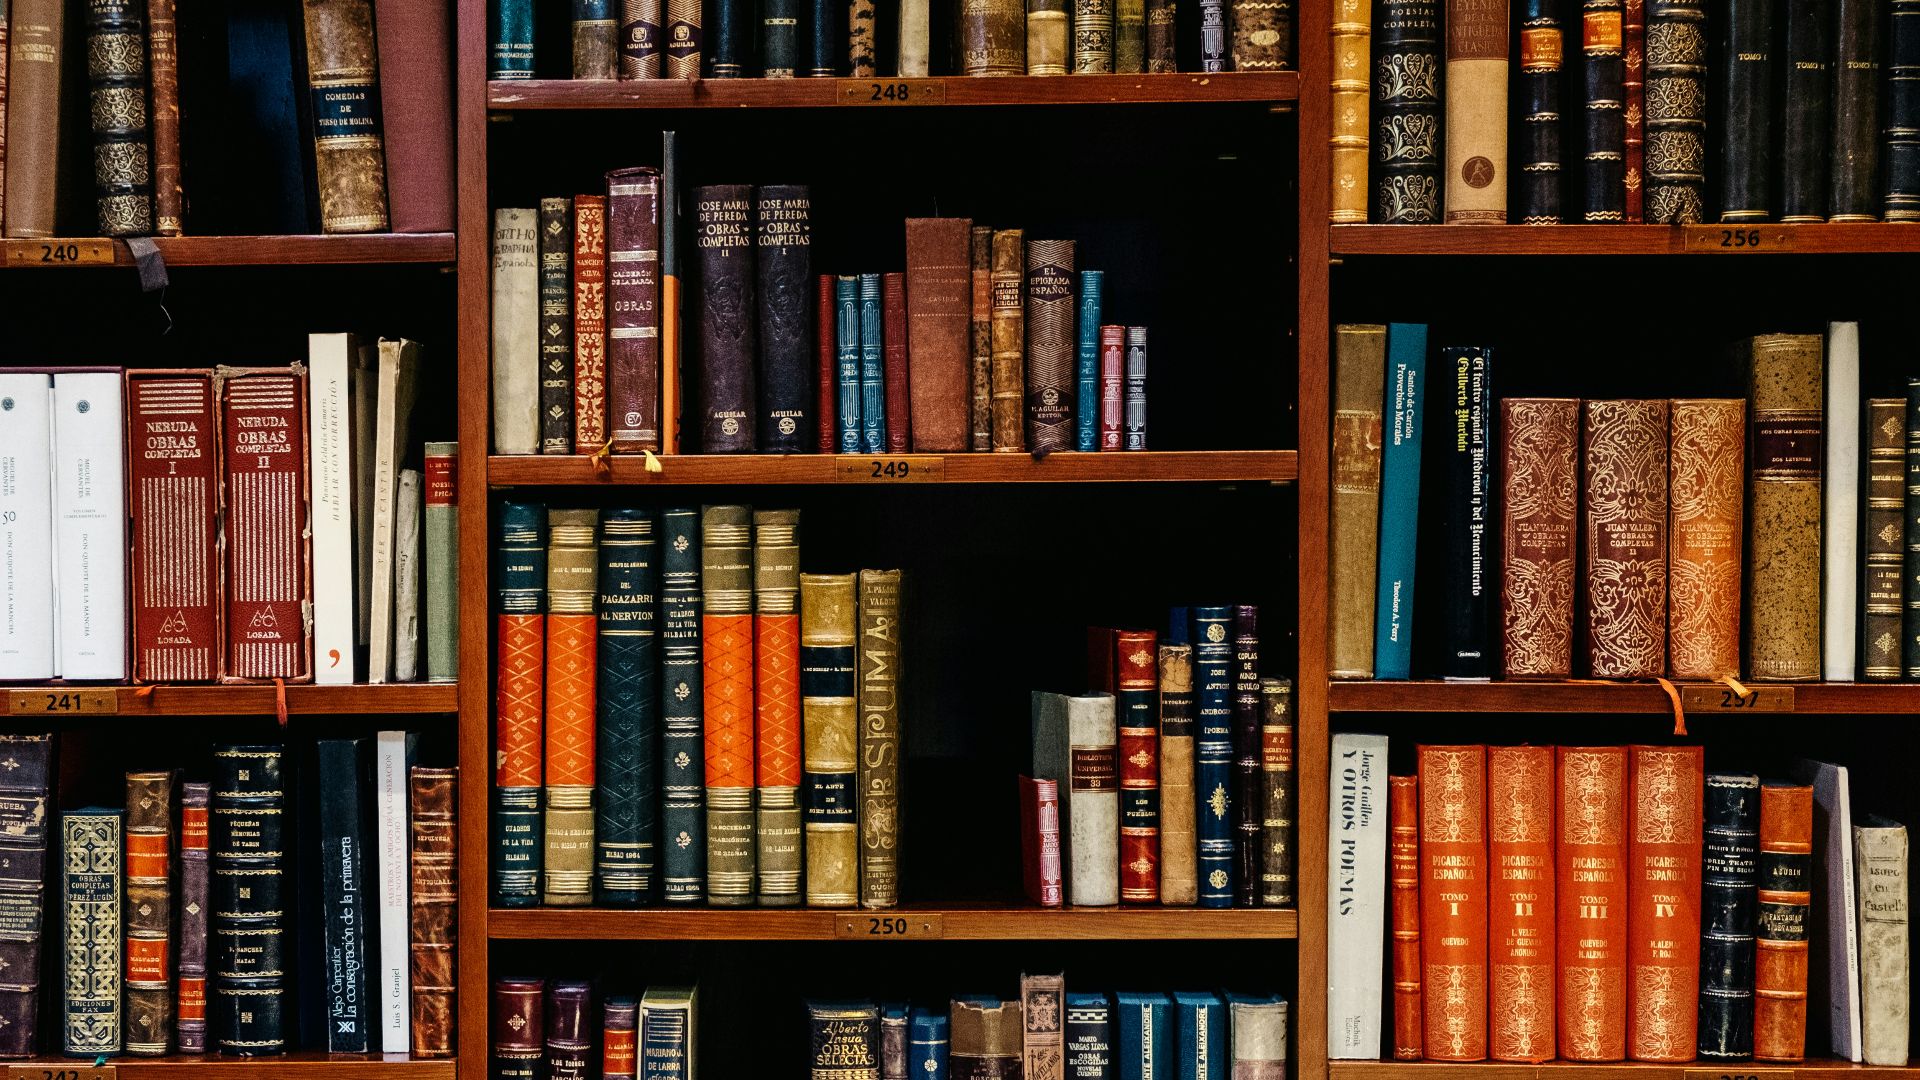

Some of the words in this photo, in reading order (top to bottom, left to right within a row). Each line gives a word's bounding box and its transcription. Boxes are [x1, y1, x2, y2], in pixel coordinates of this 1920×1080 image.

[1738, 53, 1762, 61] TOMO
[325, 92, 365, 101] COMEDIAS
[871, 83, 909, 101] 248
[340, 105, 352, 113] DE
[722, 200, 750, 210] MARIA
[758, 199, 781, 210] JOSE
[783, 199, 810, 209] MARIA
[699, 212, 710, 222] DE
[713, 211, 748, 222] PEREDA
[760, 210, 771, 220] DE
[774, 210, 809, 220] PEREDA
[706, 223, 740, 235] OBRAS
[766, 222, 801, 234] OBRAS
[697, 235, 750, 248] COMPLETAS
[758, 234, 810, 246] COMPLETAS
[1720, 230, 1760, 248] 256
[41, 245, 79, 261] 240
[721, 249, 729, 257] II
[782, 247, 787, 256] I
[1044, 267, 1057, 276] EL
[1030, 277, 1071, 286] EPIGRAMA
[1030, 284, 1070, 295] ESPAÑOL
[614, 301, 653, 312] OBRAS
[1394, 363, 1407, 410] Proverbios
[1406, 370, 1416, 398] Santob
[713, 410, 747, 418] AGUILAR
[770, 410, 803, 418] AGUILAR
[145, 421, 198, 433] NERUDA
[236, 416, 288, 428] NERUDA
[1405, 409, 1414, 439] Carrión
[1393, 410, 1405, 446] Morales
[146, 435, 197, 449] OBRAS
[237, 430, 287, 444] OBRAS
[144, 448, 201, 459] COMPLETAS
[235, 443, 292, 454] COMPLETAS
[168, 461, 177, 475] I
[257, 456, 270, 469] II
[871, 461, 909, 478] 249
[1516, 523, 1540, 532] JUAN
[1541, 523, 1570, 532] VALERA
[1605, 523, 1628, 532] JUAN
[1629, 523, 1657, 532] VALERA
[1680, 523, 1704, 532] JUAN
[1532, 532, 1559, 540] OBRAS
[1621, 532, 1647, 540] OBRAS
[1696, 532, 1723, 540] OBRAS
[1521, 539, 1566, 548] COMPLETAS
[1609, 539, 1655, 547] COMPLETAS
[1685, 539, 1731, 548] COMPLETAS
[601, 594, 654, 604] PAGAZARRI
[601, 612, 611, 621] AL
[612, 611, 654, 621] NERVION
[157, 636, 192, 645] LOSADA
[246, 631, 281, 640] LOSADA
[1237, 652, 1258, 660] COPLAS
[1243, 662, 1252, 670] DE
[1239, 672, 1257, 680] MINGO
[46, 694, 83, 711] 241
[1720, 690, 1760, 708] 257
[1342, 750, 1357, 760] Y
[1089, 779, 1101, 788] 33
[1341, 768, 1357, 831] OTROS
[2, 859, 10, 868] 2
[338, 836, 357, 891] primavera
[1432, 855, 1476, 867] PICARESCA
[1502, 855, 1544, 867] PICARESCA
[1572, 857, 1616, 869] PICARESCA
[1645, 856, 1688, 868] PICARESCA
[1339, 840, 1356, 917] POEMAS
[1433, 868, 1475, 880] ESPAÑOLA
[1502, 868, 1543, 880] ESPAÑOLA
[1573, 870, 1615, 882] ESPAÑOLA
[1646, 869, 1687, 881] ESPAÑOLA
[71, 882, 110, 890] COMPLETAS
[339, 894, 353, 905] la
[1440, 893, 1469, 901] TOMO
[1509, 893, 1538, 901] TOMO
[1579, 895, 1609, 904] TOMO
[1652, 894, 1681, 903] TOMO
[1450, 902, 1459, 916] I
[1514, 902, 1534, 916] II
[1579, 905, 1609, 919] III
[1655, 903, 1679, 918] IV
[339, 907, 354, 926] de
[868, 918, 908, 934] 250
[1441, 937, 1469, 946] QUEVEDO
[1579, 939, 1608, 948] QUEVEDO
[343, 927, 361, 1003] consagración
[391, 967, 401, 998] Granjel
[343, 1004, 356, 1019] La
[392, 1012, 401, 1029] Luis
[822, 1021, 869, 1034] Alberto
[1143, 1007, 1151, 1061] ALEIXANDRE
[1197, 1007, 1206, 1061] ALEIXANDRE
[822, 1043, 868, 1055] OBRAS
[1068, 1042, 1090, 1050] VARGAS
[1090, 1042, 1109, 1050] LLOSA
[646, 1048, 676, 1057] MARIANO
[816, 1054, 875, 1066] SELECTAS
[647, 1062, 657, 1070] DE
[658, 1062, 680, 1070] LARRA
